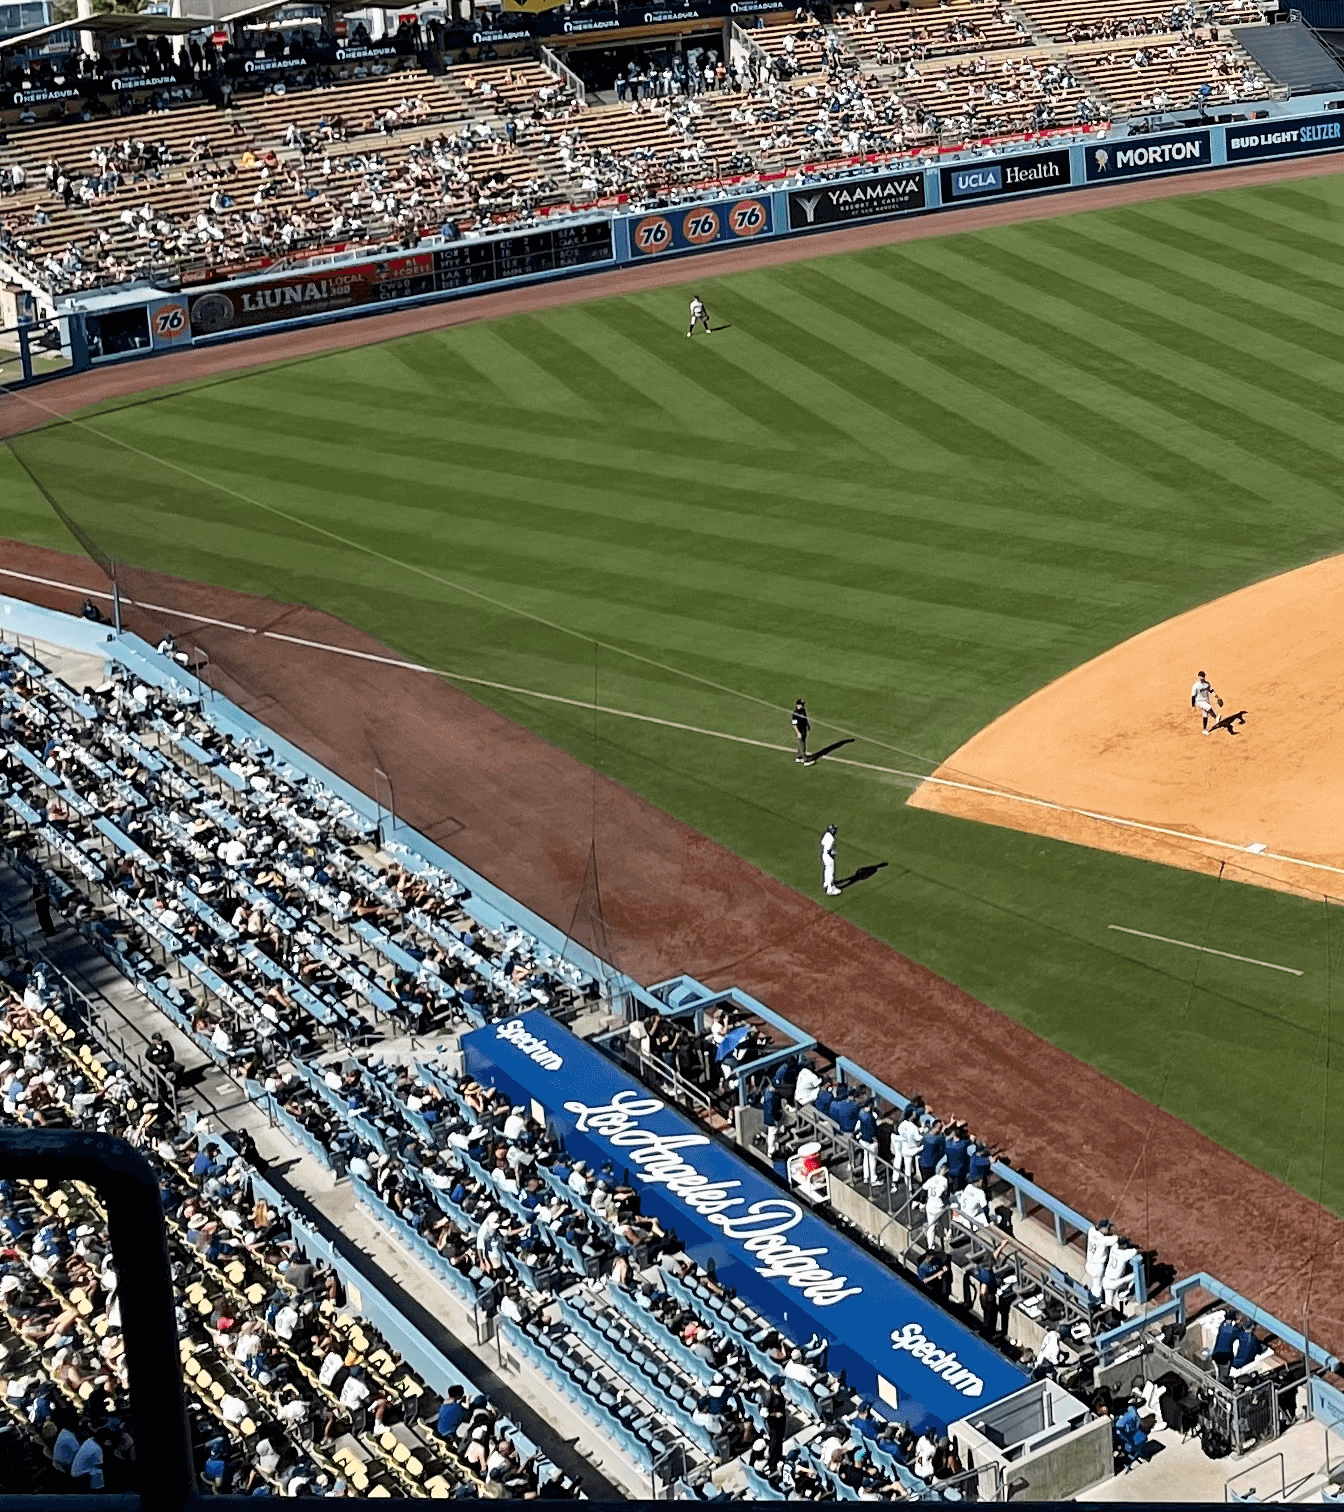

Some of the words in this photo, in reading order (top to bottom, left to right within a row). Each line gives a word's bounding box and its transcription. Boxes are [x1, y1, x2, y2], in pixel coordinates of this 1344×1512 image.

[1231, 136, 1259, 150] BUD
[1260, 130, 1299, 147] LIGHT
[1299, 122, 1341, 143] SELTZER
[1116, 141, 1200, 169] MORTON
[957, 172, 997, 190] UCLA
[1005, 161, 1060, 184] Health
[640, 223, 667, 246] 76
[687, 214, 715, 237] 76
[734, 205, 762, 228] 76
[241, 280, 328, 312] LiUNA!
[328, 273, 365, 287] LOCAL
[156, 312, 183, 337] 76
[495, 1018, 564, 1072] Spectrum
[563, 1090, 666, 1146] Los
[610, 1130, 746, 1215] Angeles
[707, 1199, 863, 1307] Dodgers
[890, 1322, 984, 1398] Spectrum
